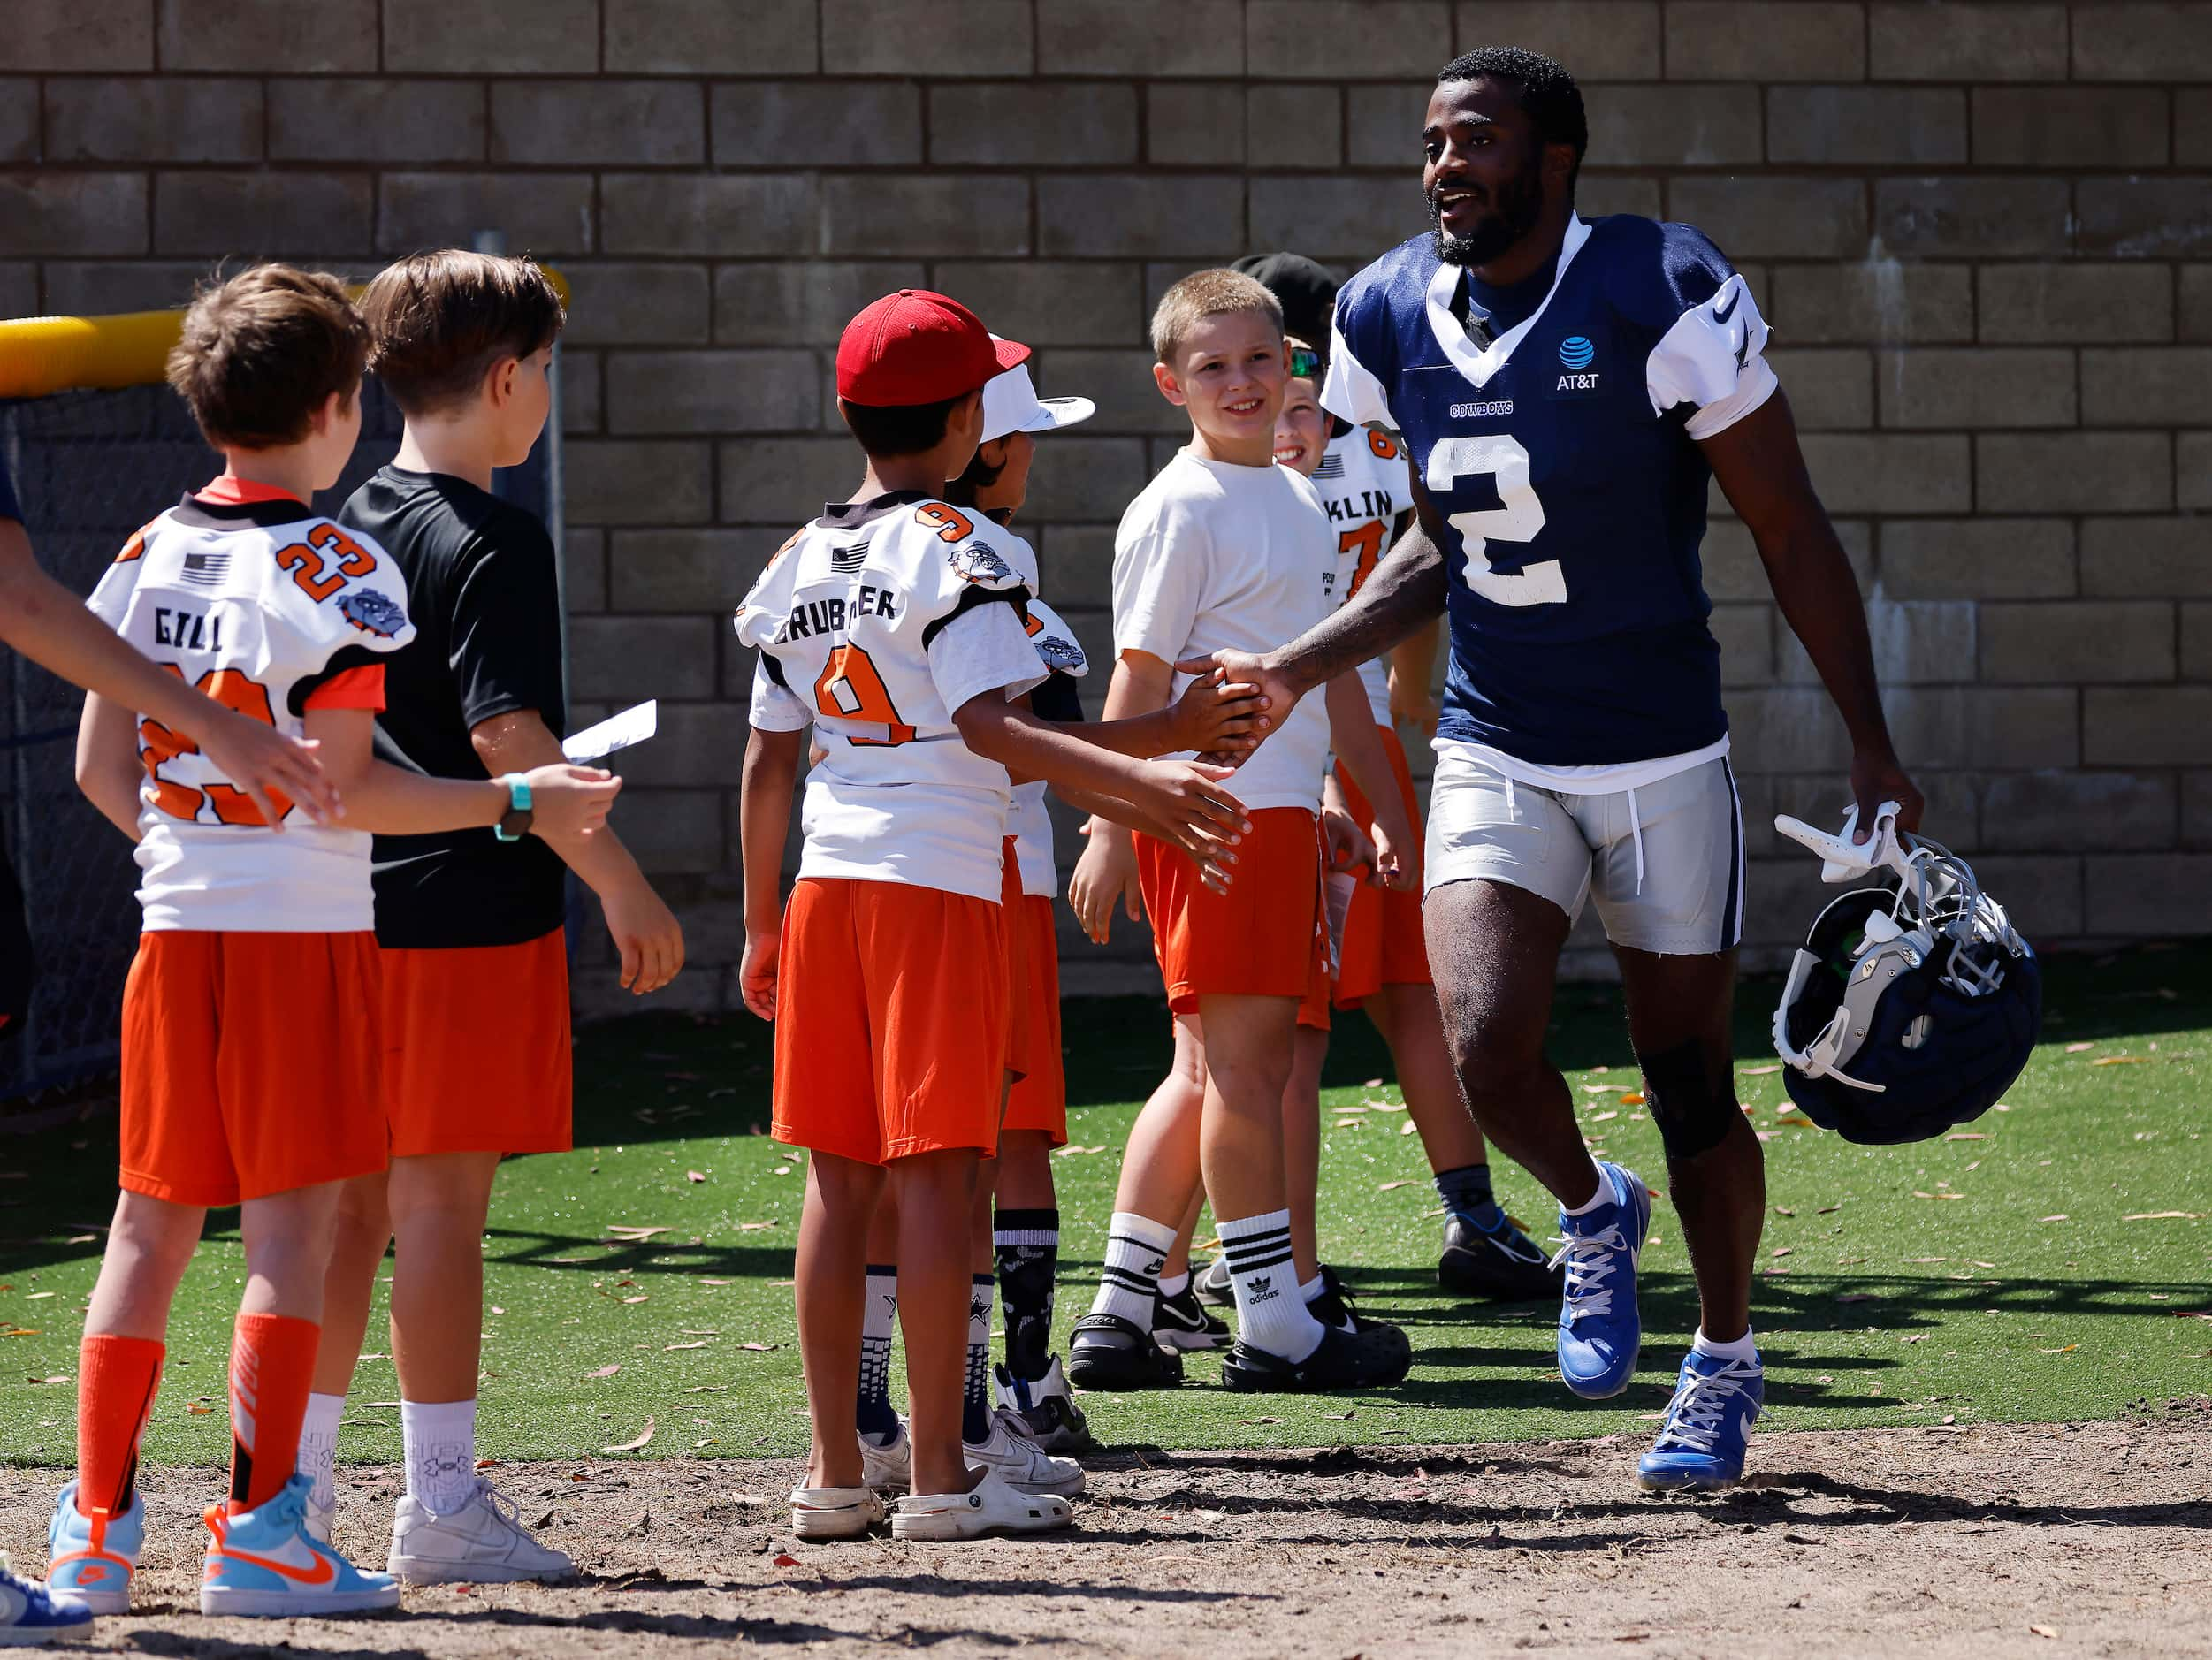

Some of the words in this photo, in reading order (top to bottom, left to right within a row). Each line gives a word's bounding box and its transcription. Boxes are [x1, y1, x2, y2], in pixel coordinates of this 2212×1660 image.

[1556, 374, 1599, 391] AT&T
[1450, 400, 1514, 418] COWBOYS
[915, 502, 974, 544] 9
[1323, 490, 1393, 523] KLIN
[1427, 434, 1568, 607] 2
[276, 522, 377, 603] 23
[155, 607, 224, 651] GILL
[1249, 1288, 1279, 1306] adidas
